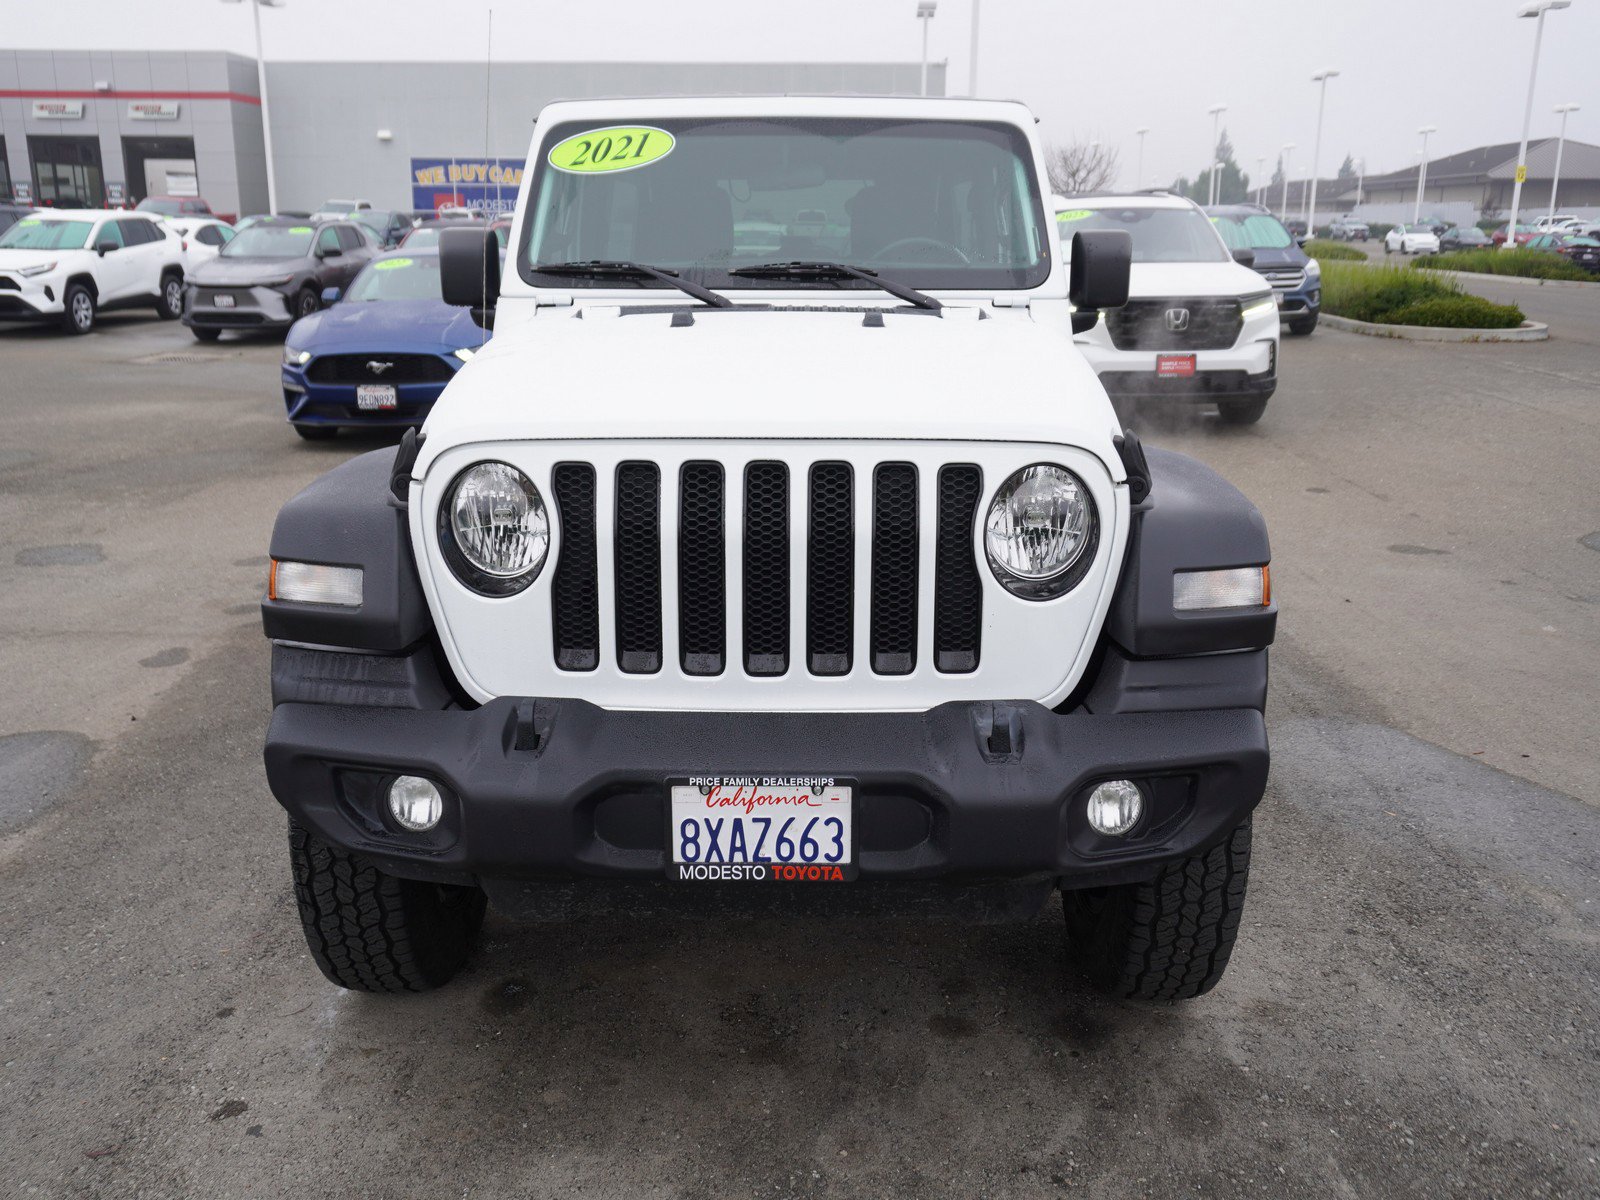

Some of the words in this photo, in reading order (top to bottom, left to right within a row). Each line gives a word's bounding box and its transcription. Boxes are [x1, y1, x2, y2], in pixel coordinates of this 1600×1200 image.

[569, 132, 651, 166] 2021
[415, 166, 446, 185] WE
[448, 164, 489, 182] BUY
[689, 778, 720, 786] PRICE
[723, 778, 760, 786] FAMILY
[762, 777, 835, 786] DEALERSHIPS
[706, 786, 822, 814] California
[680, 816, 844, 863] 8XAZ663
[679, 865, 766, 880] MODESTO
[771, 865, 844, 880] TOYOTA
